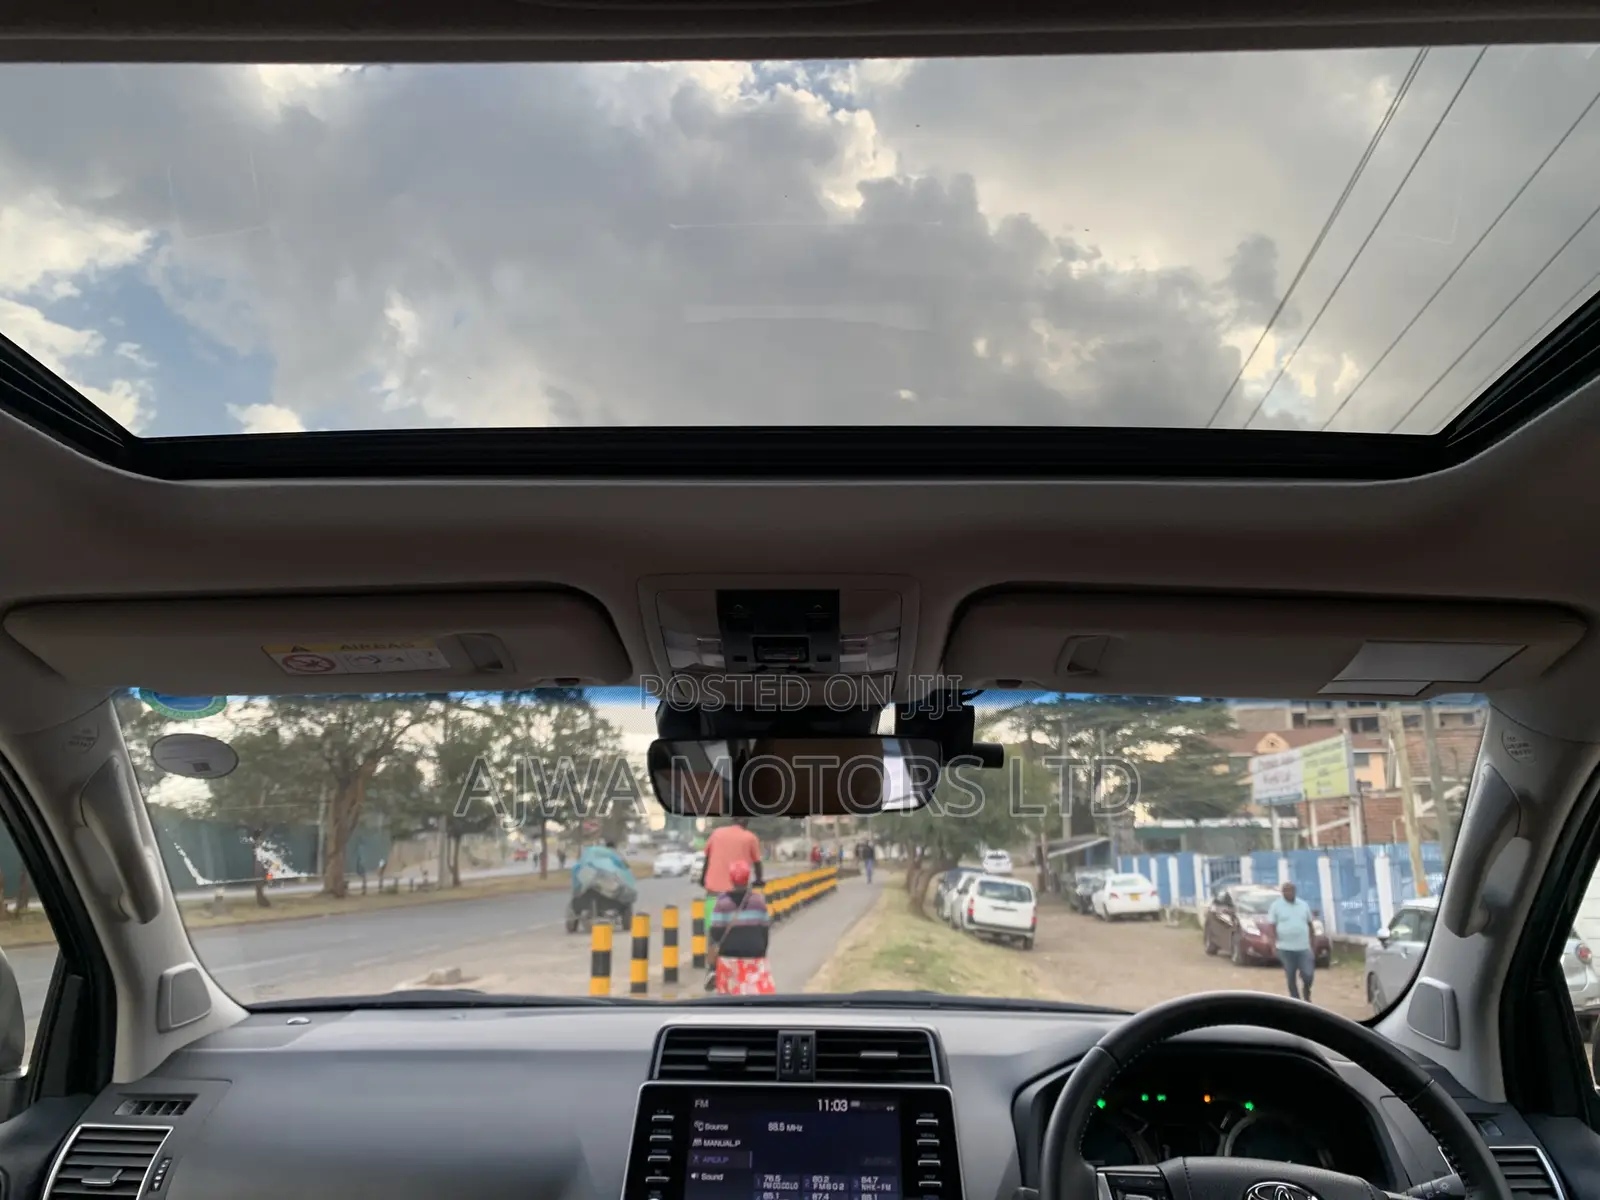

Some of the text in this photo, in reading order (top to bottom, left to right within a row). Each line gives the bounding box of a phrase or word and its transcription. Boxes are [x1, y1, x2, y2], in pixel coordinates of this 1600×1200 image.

[695, 1100, 709, 1108] FM
[818, 1099, 848, 1112] 11:03
[705, 1123, 729, 1131] Source
[701, 1173, 724, 1181] Sound
